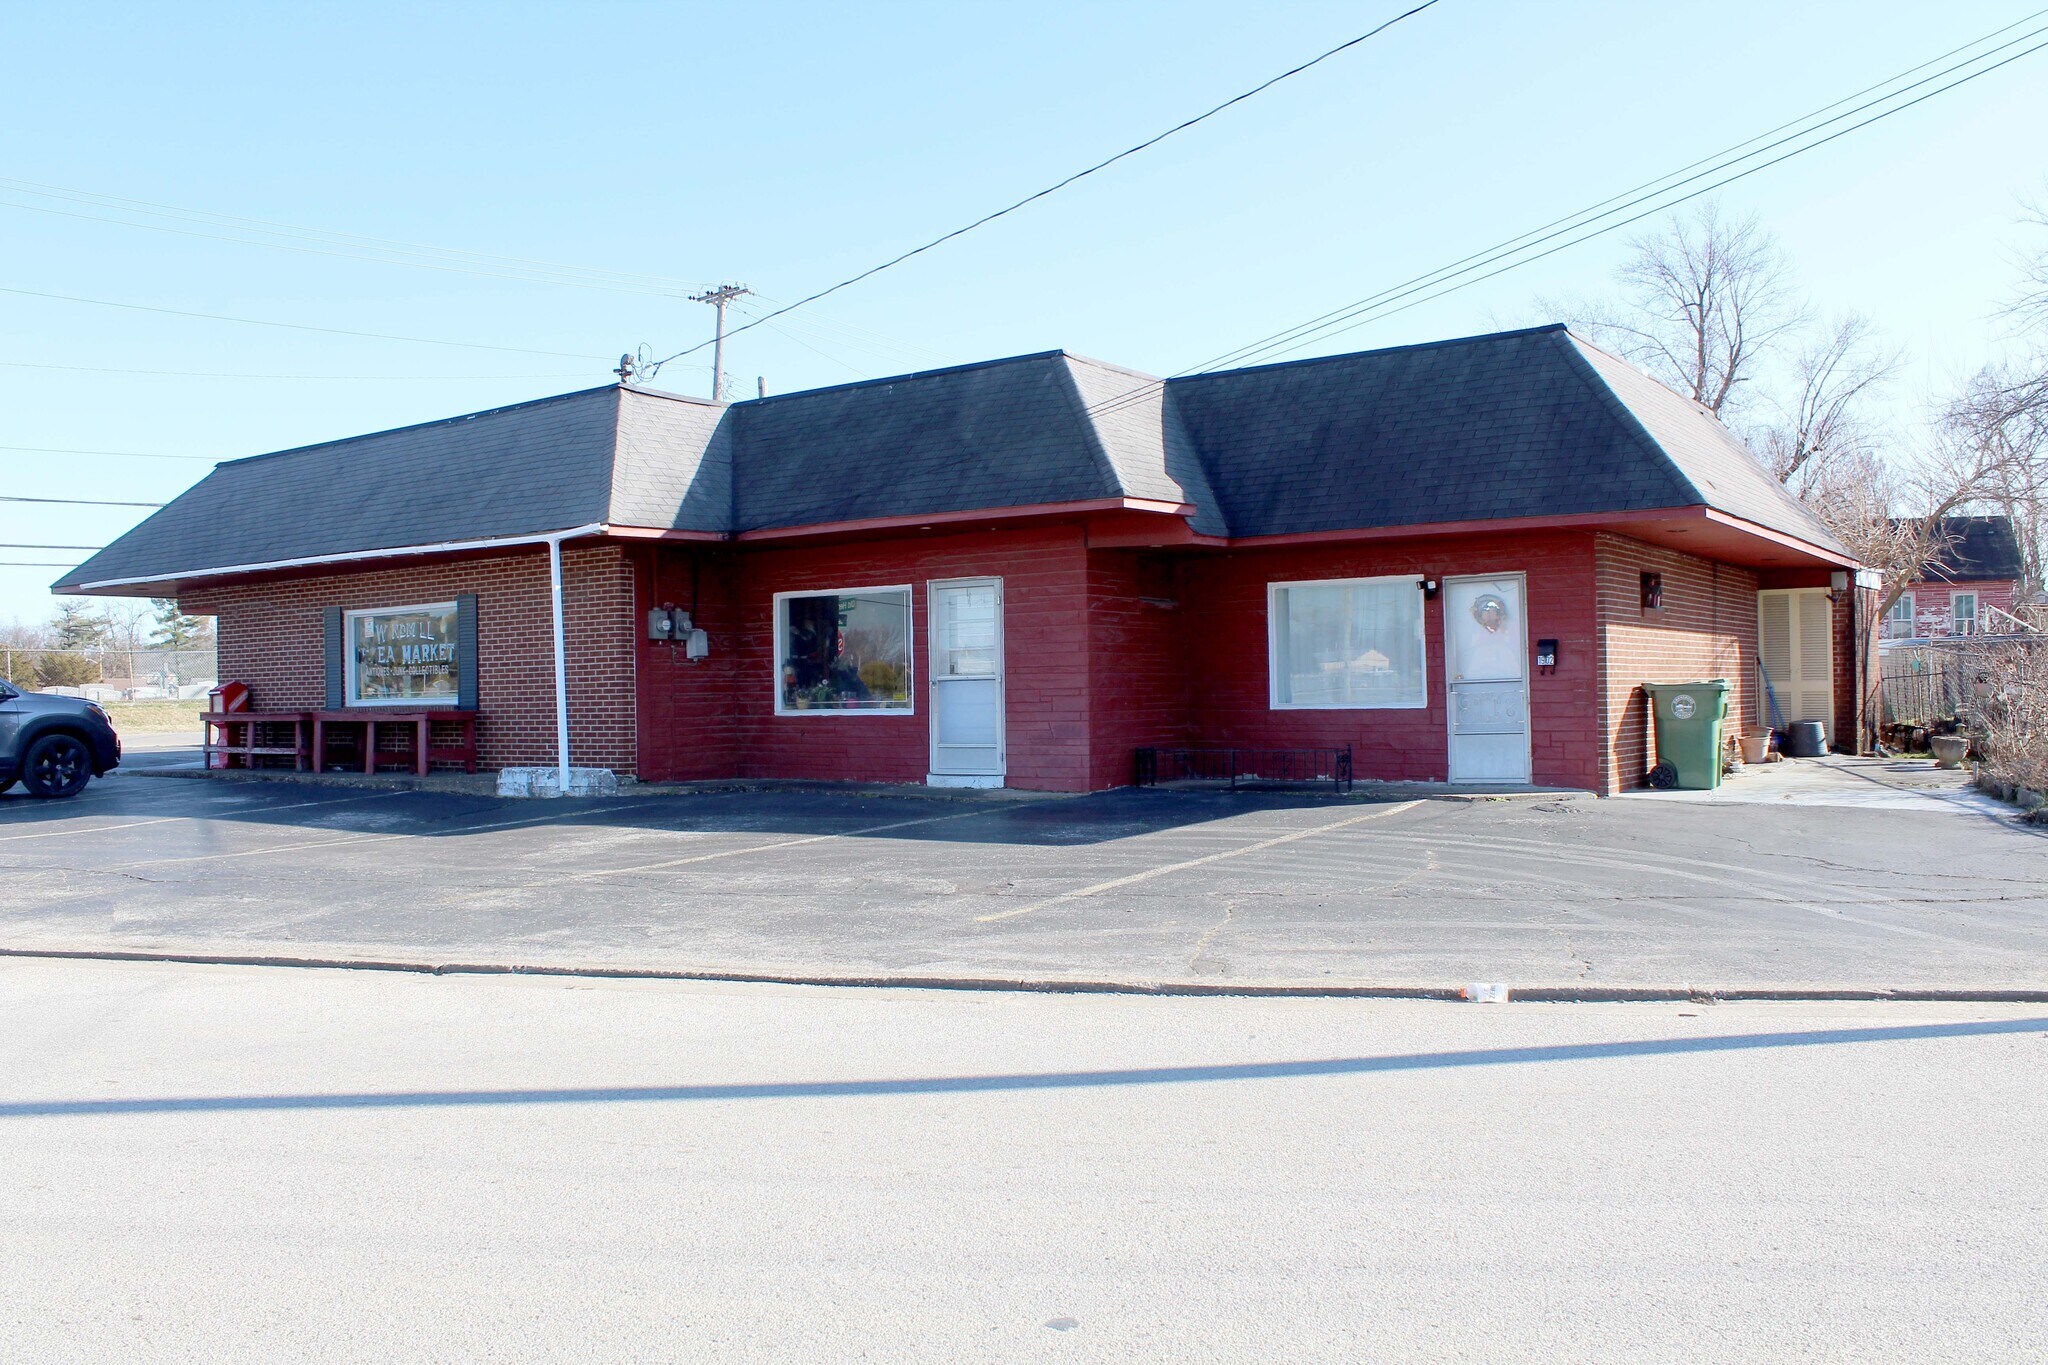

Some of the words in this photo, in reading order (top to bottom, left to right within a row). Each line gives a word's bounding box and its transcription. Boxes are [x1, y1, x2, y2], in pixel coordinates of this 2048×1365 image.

[375, 620, 435, 644] WNDMLL
[402, 643, 455, 664] MARKET
[408, 665, 449, 675] COLLECTIBLES
